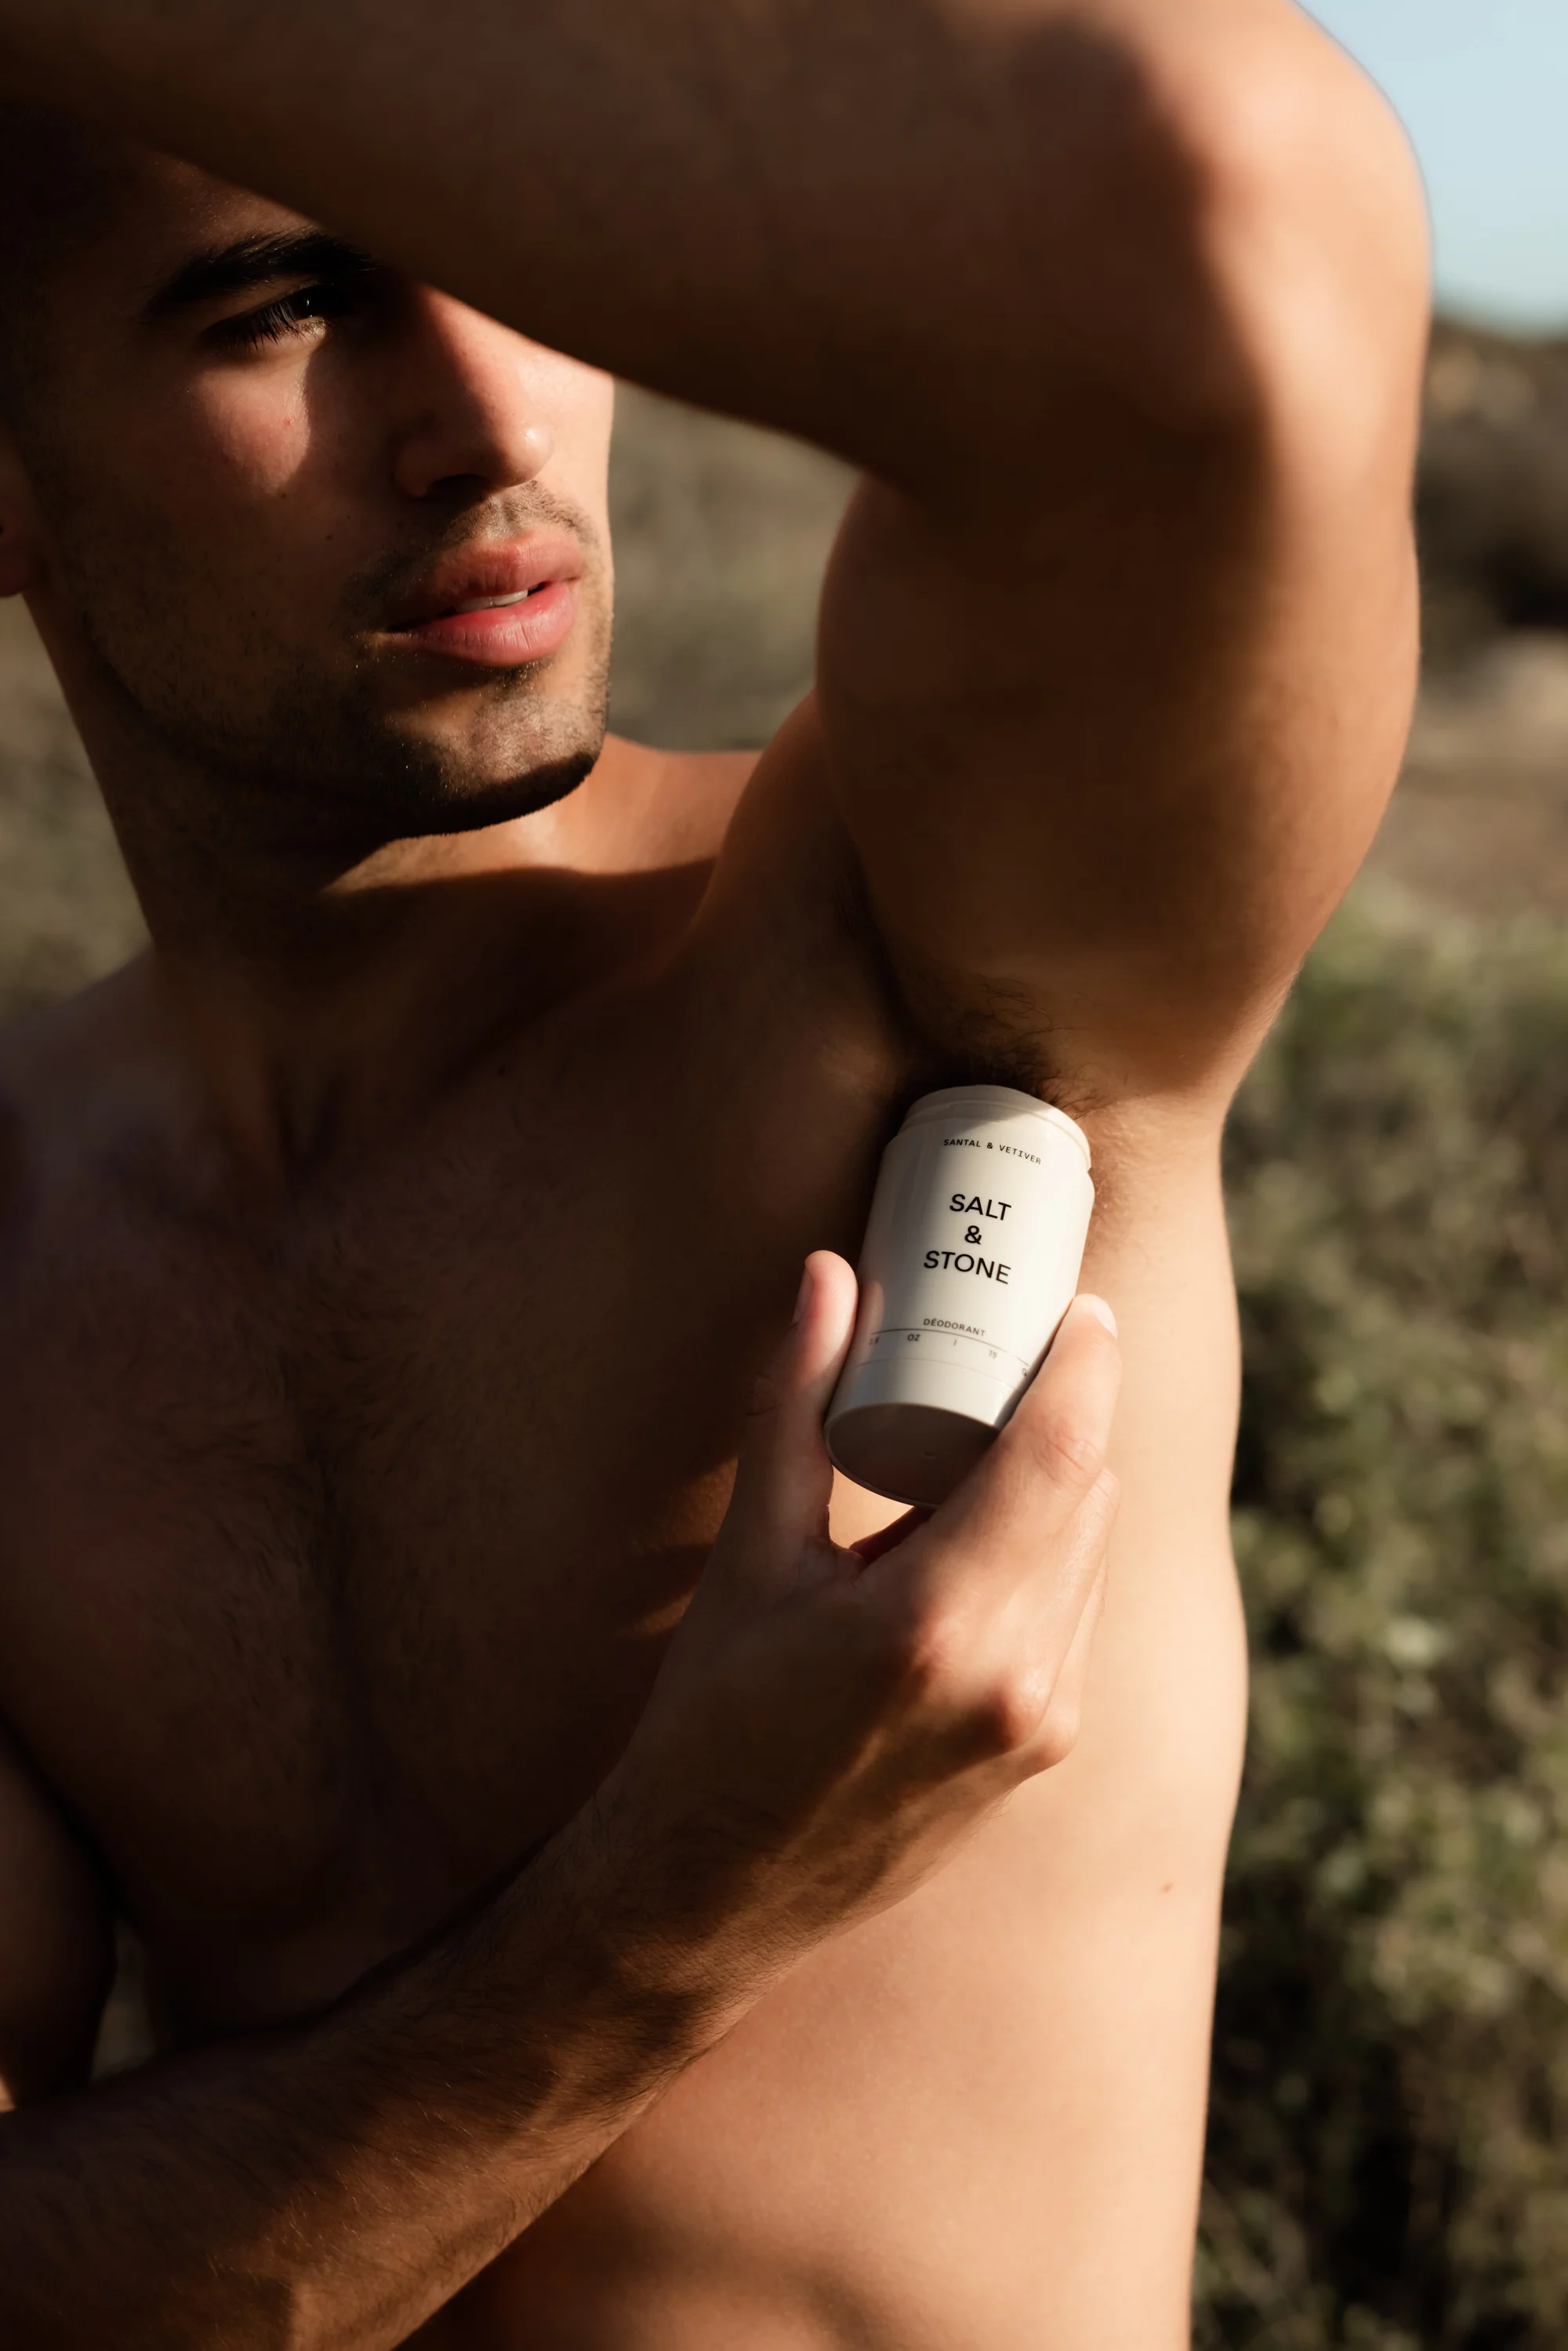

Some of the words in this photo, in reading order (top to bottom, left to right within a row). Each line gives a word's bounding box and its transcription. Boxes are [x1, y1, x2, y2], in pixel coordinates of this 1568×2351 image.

[943, 1138, 981, 1148] SANTAL
[999, 1144, 1041, 1165] VETIVER
[949, 1193, 1012, 1221] SALT
[964, 1224, 982, 1246] &
[924, 1250, 1011, 1285] STONE
[907, 1333, 920, 1342] OZ
